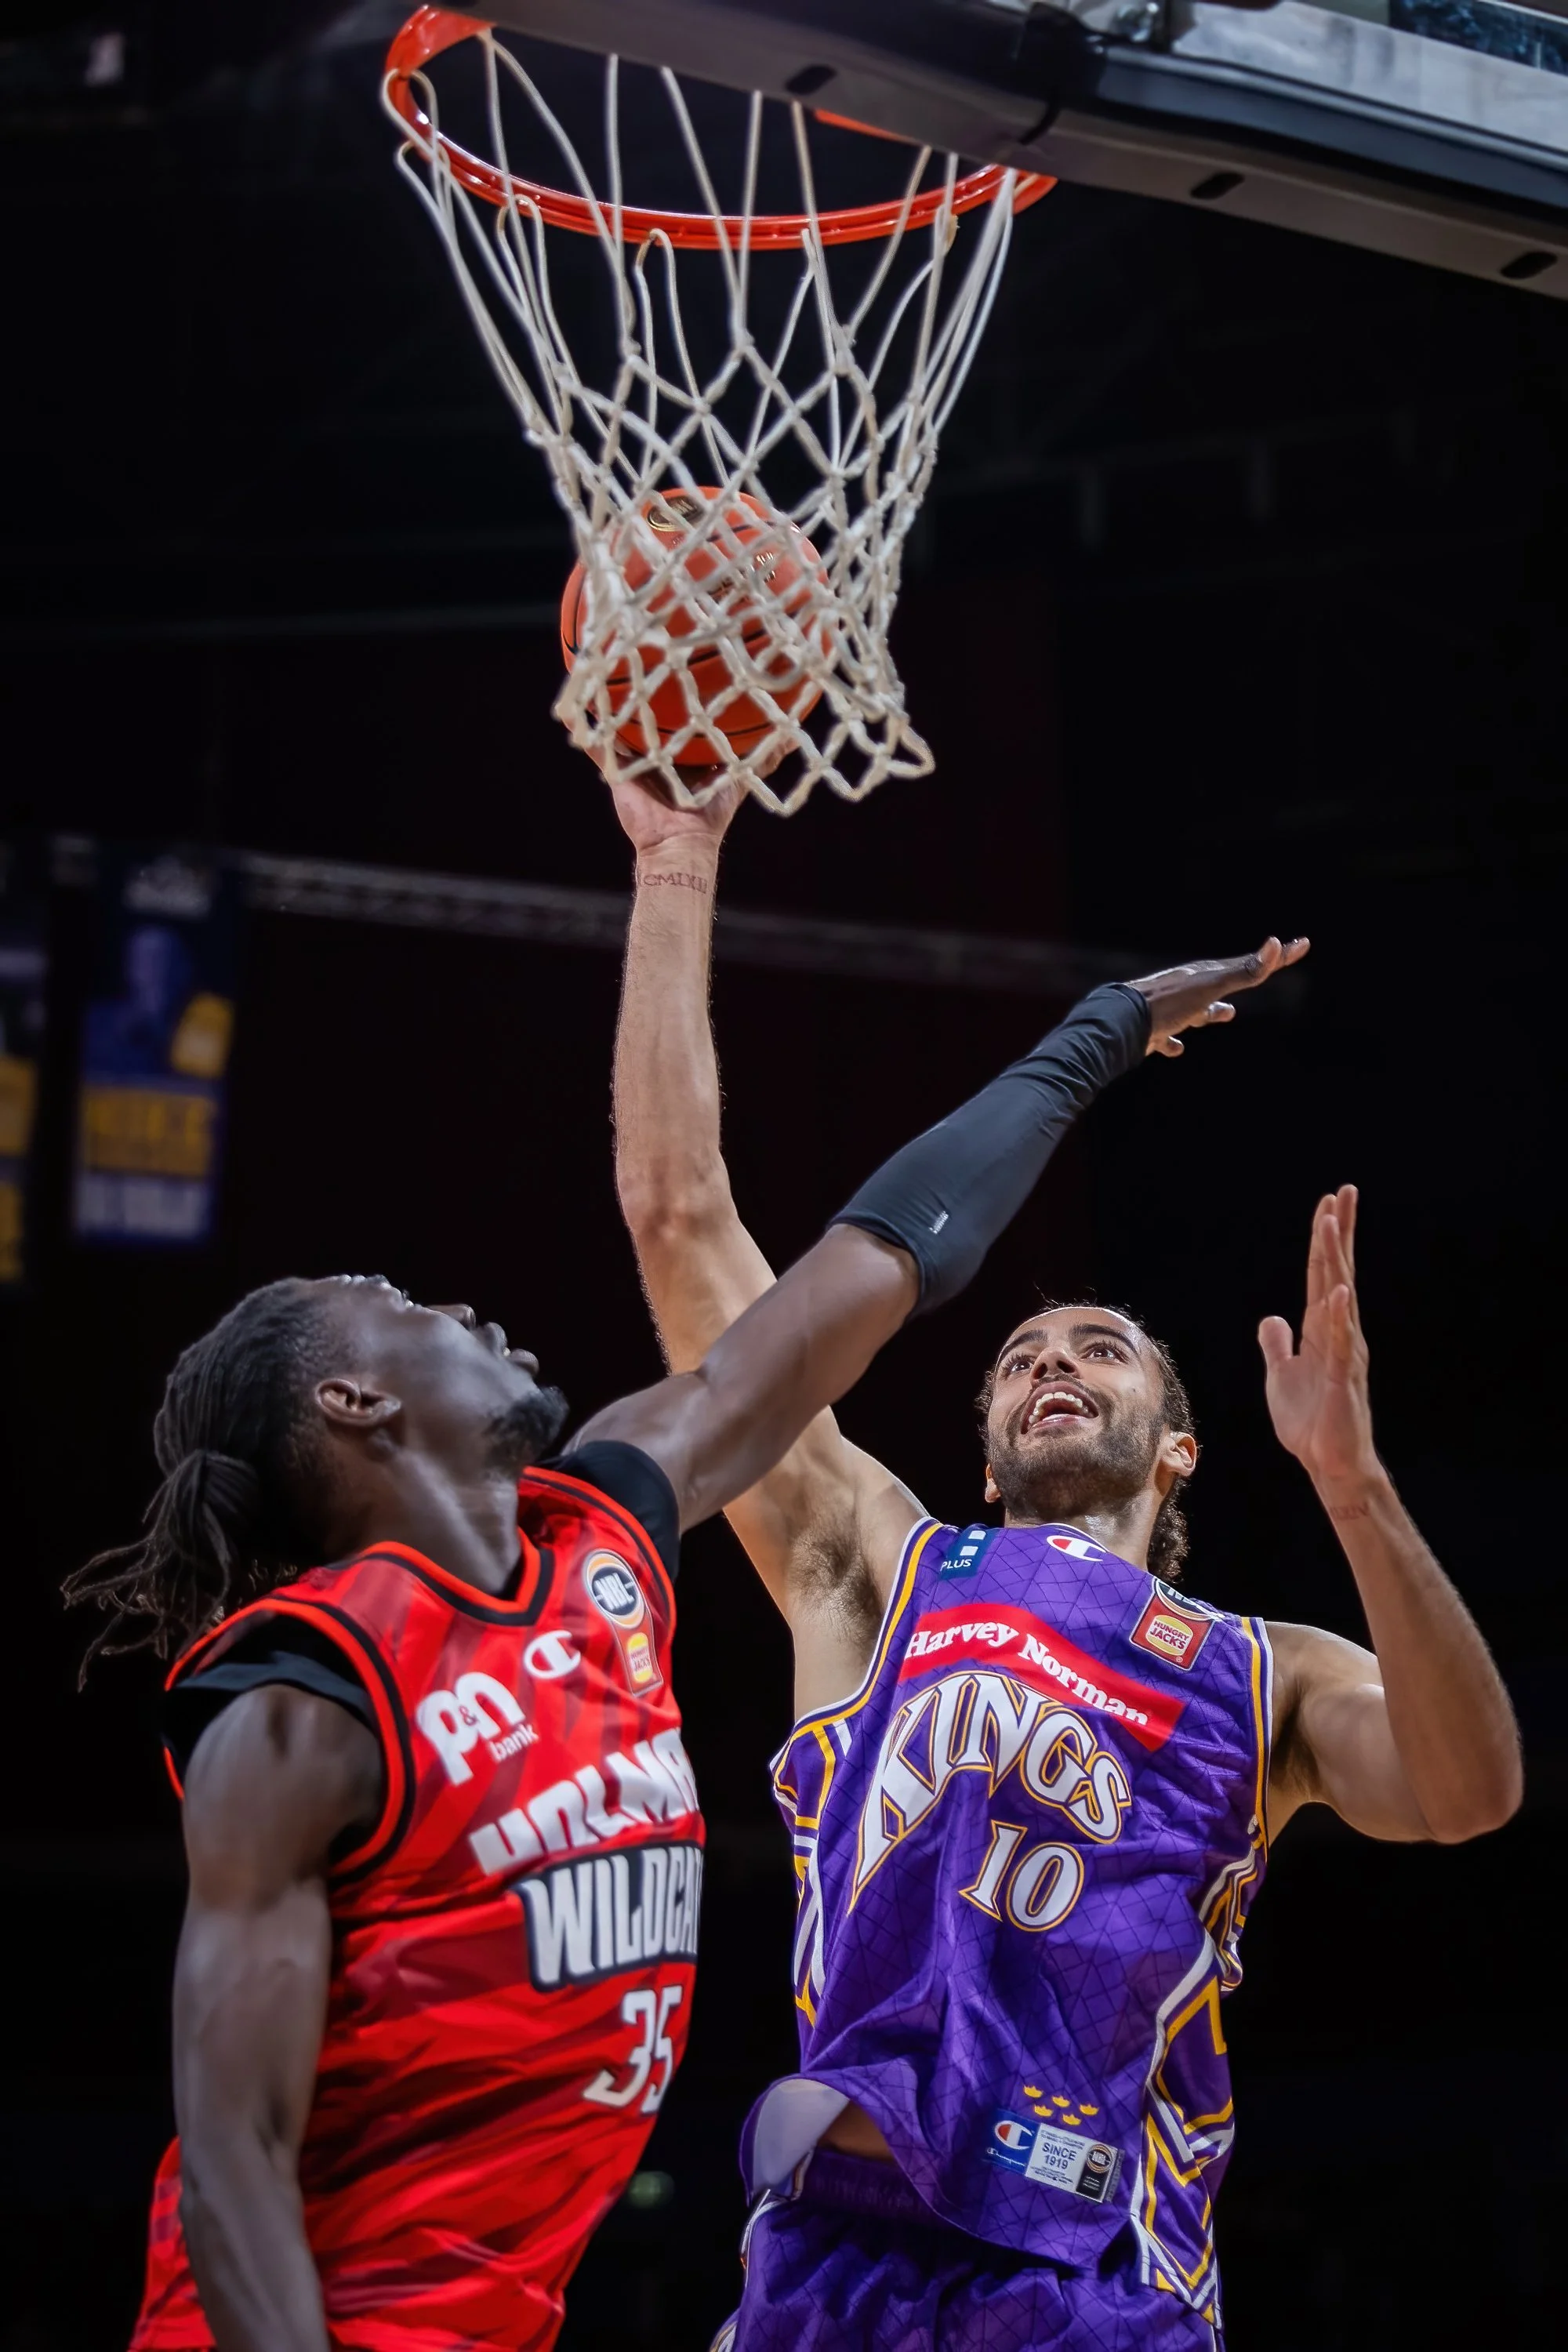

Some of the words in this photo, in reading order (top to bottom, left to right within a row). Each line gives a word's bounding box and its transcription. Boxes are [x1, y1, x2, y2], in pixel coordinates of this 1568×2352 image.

[940, 1559, 972, 1572] PLUS
[1153, 1620, 1189, 1641] HUNGRY
[903, 1621, 1019, 1661] Harvey
[1018, 1633, 1149, 1726] Norman
[490, 1723, 539, 1762] bank
[848, 1670, 1132, 1917] KINGS
[959, 1820, 1084, 1933] 10
[583, 1984, 684, 2114] 35
[1042, 2142, 1077, 2161] SINCE
[1044, 2154, 1069, 2170] 1919
